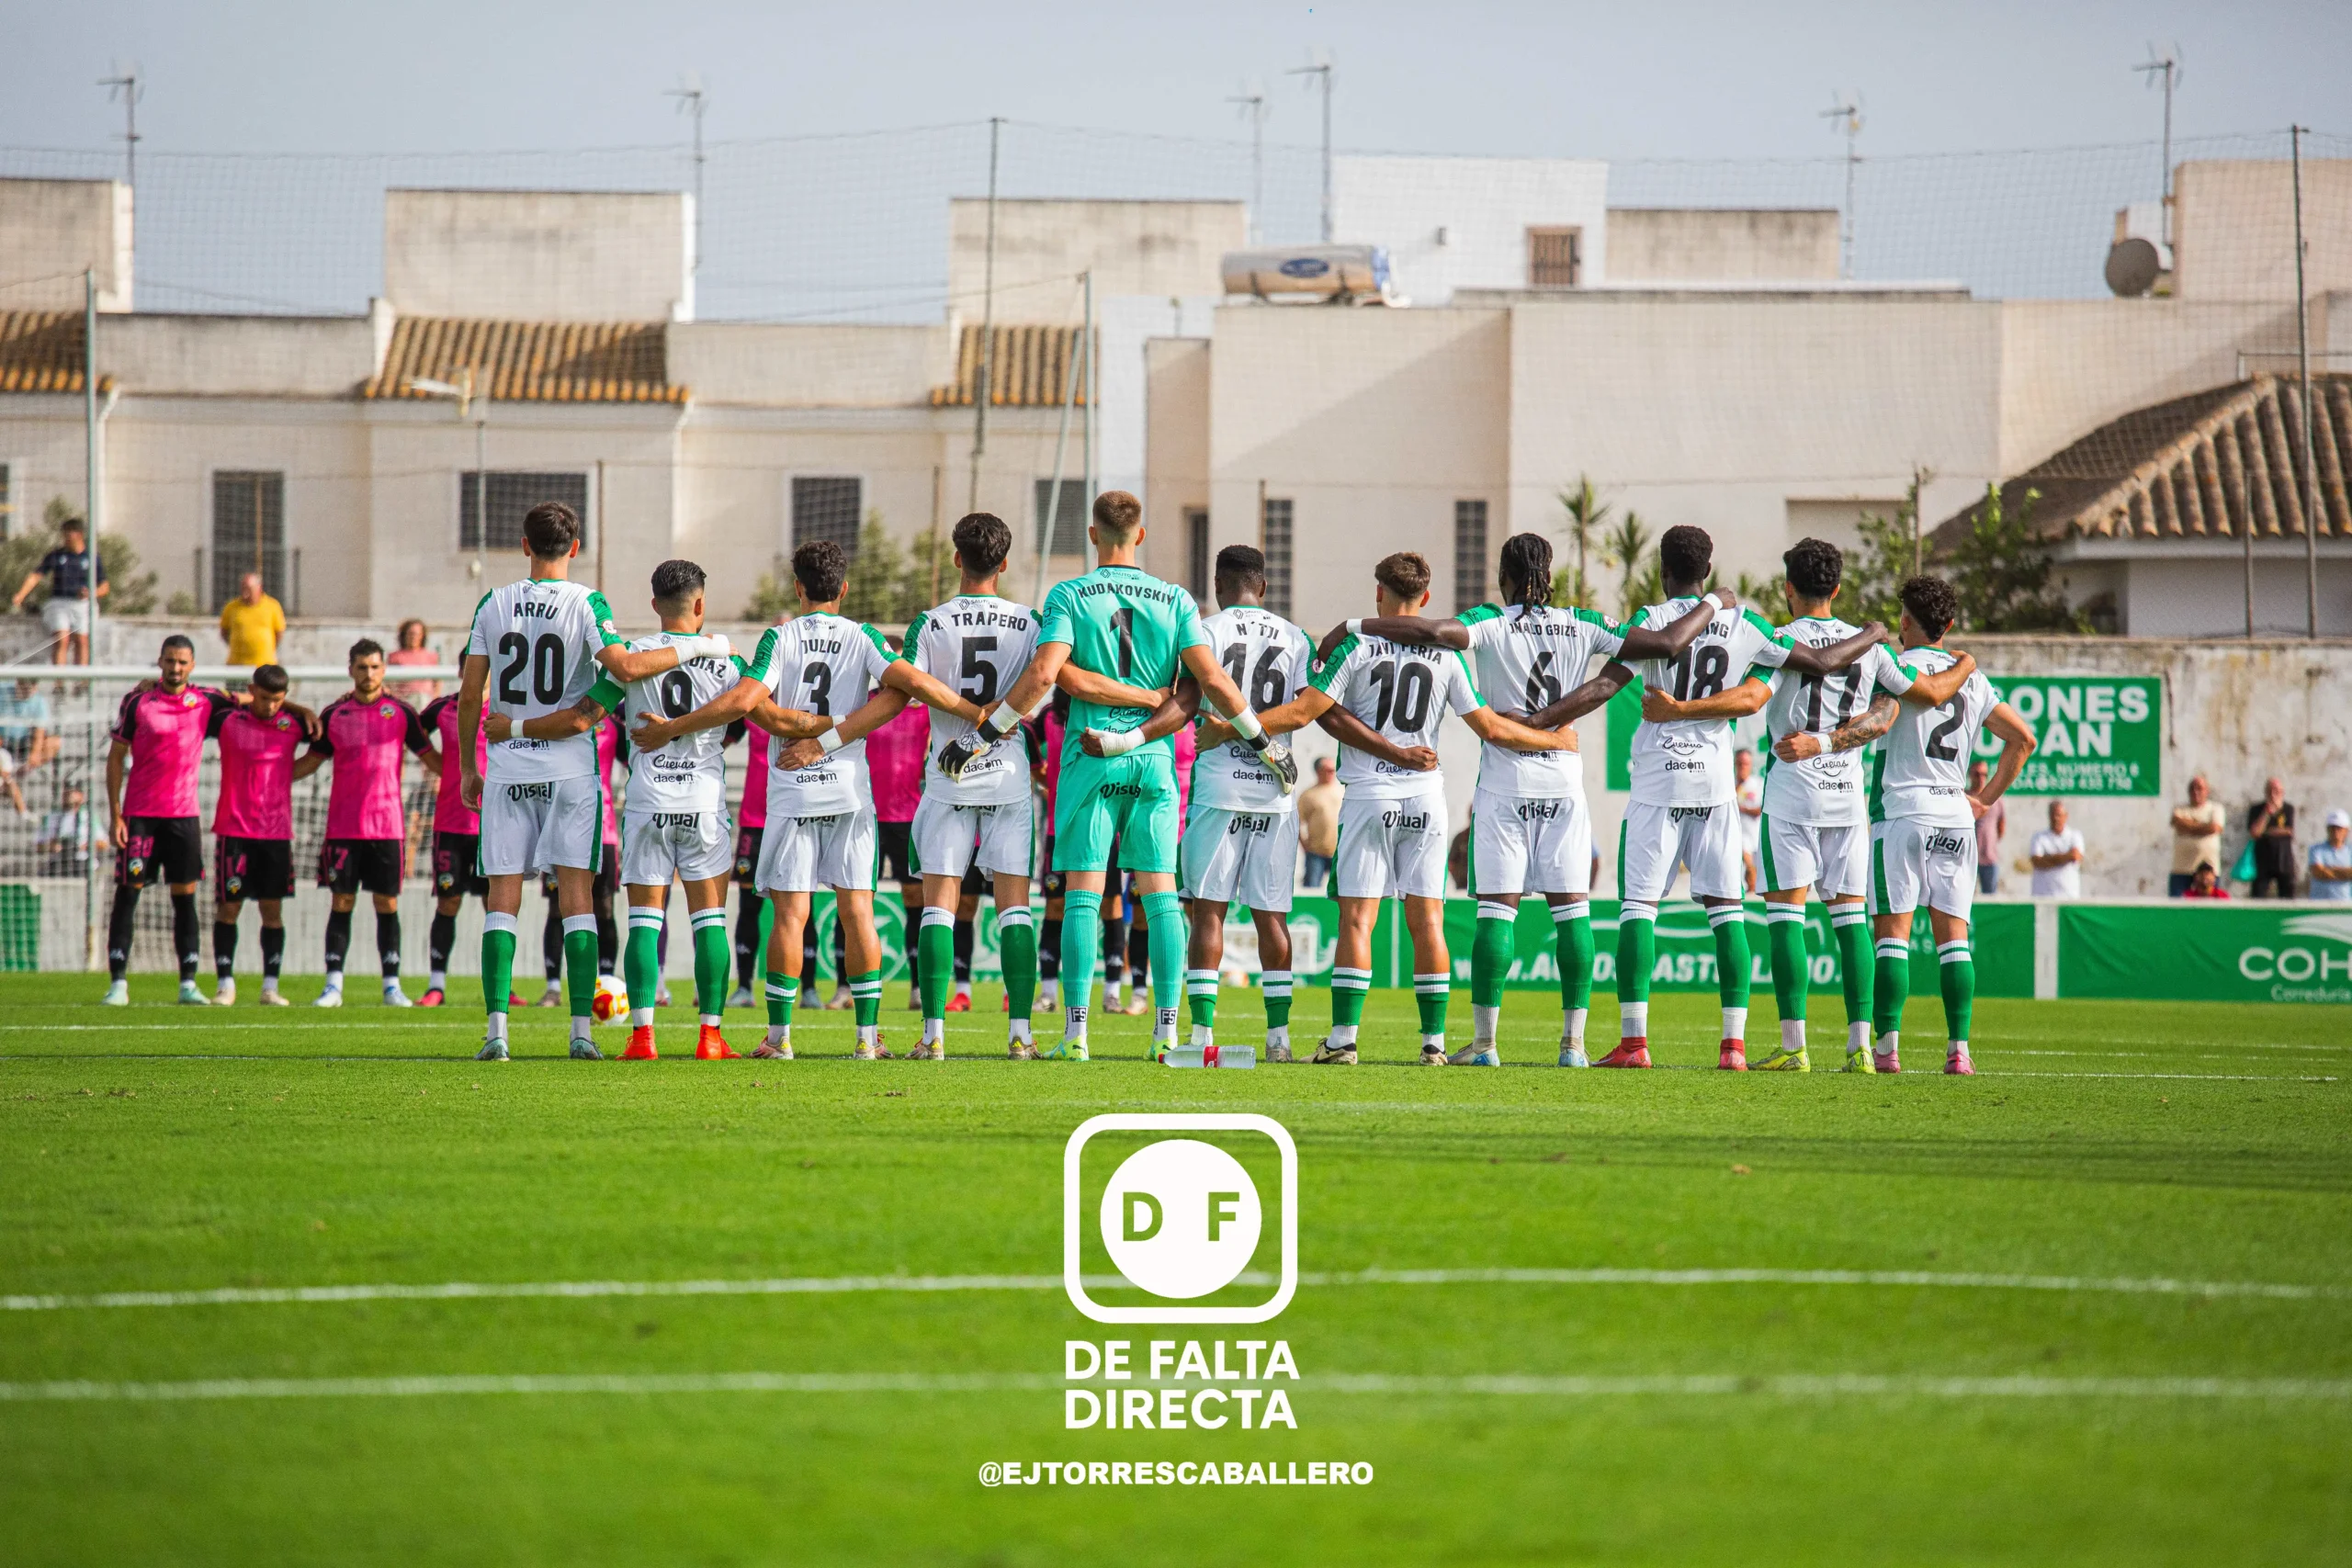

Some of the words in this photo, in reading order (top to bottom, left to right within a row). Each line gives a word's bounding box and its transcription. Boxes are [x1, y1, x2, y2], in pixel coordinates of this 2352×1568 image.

[1078, 582, 1175, 605] KUDAKOVSKIY
[514, 602, 559, 620] ARRU
[931, 618, 944, 632] A.
[951, 611, 1028, 632] TRAPERO
[801, 639, 842, 654] JULIO
[1110, 608, 1133, 678] 1
[1401, 643, 1442, 665] FERIA
[499, 631, 565, 705] 20
[689, 656, 727, 678] DIAZ
[961, 637, 997, 706] 5
[1222, 642, 1285, 713] 16
[1667, 645, 1728, 701] 18
[799, 662, 831, 716] 3
[1526, 651, 1561, 714] 6
[661, 671, 692, 741] 9
[1370, 660, 1433, 733] 10
[1926, 693, 1965, 761] 2
[653, 753, 695, 770] Cuevas
[964, 759, 1002, 773] dacom
[1665, 759, 1704, 773] dacom
[1813, 757, 1849, 770] Cuevas
[654, 774, 693, 784] dacom
[797, 772, 837, 784] dacom
[1233, 769, 1272, 782] dacom
[1818, 779, 1853, 791] dacom
[1382, 811, 1427, 829] Viual
[1073, 1009, 1086, 1022] FS
[1161, 1010, 1175, 1024] FS
